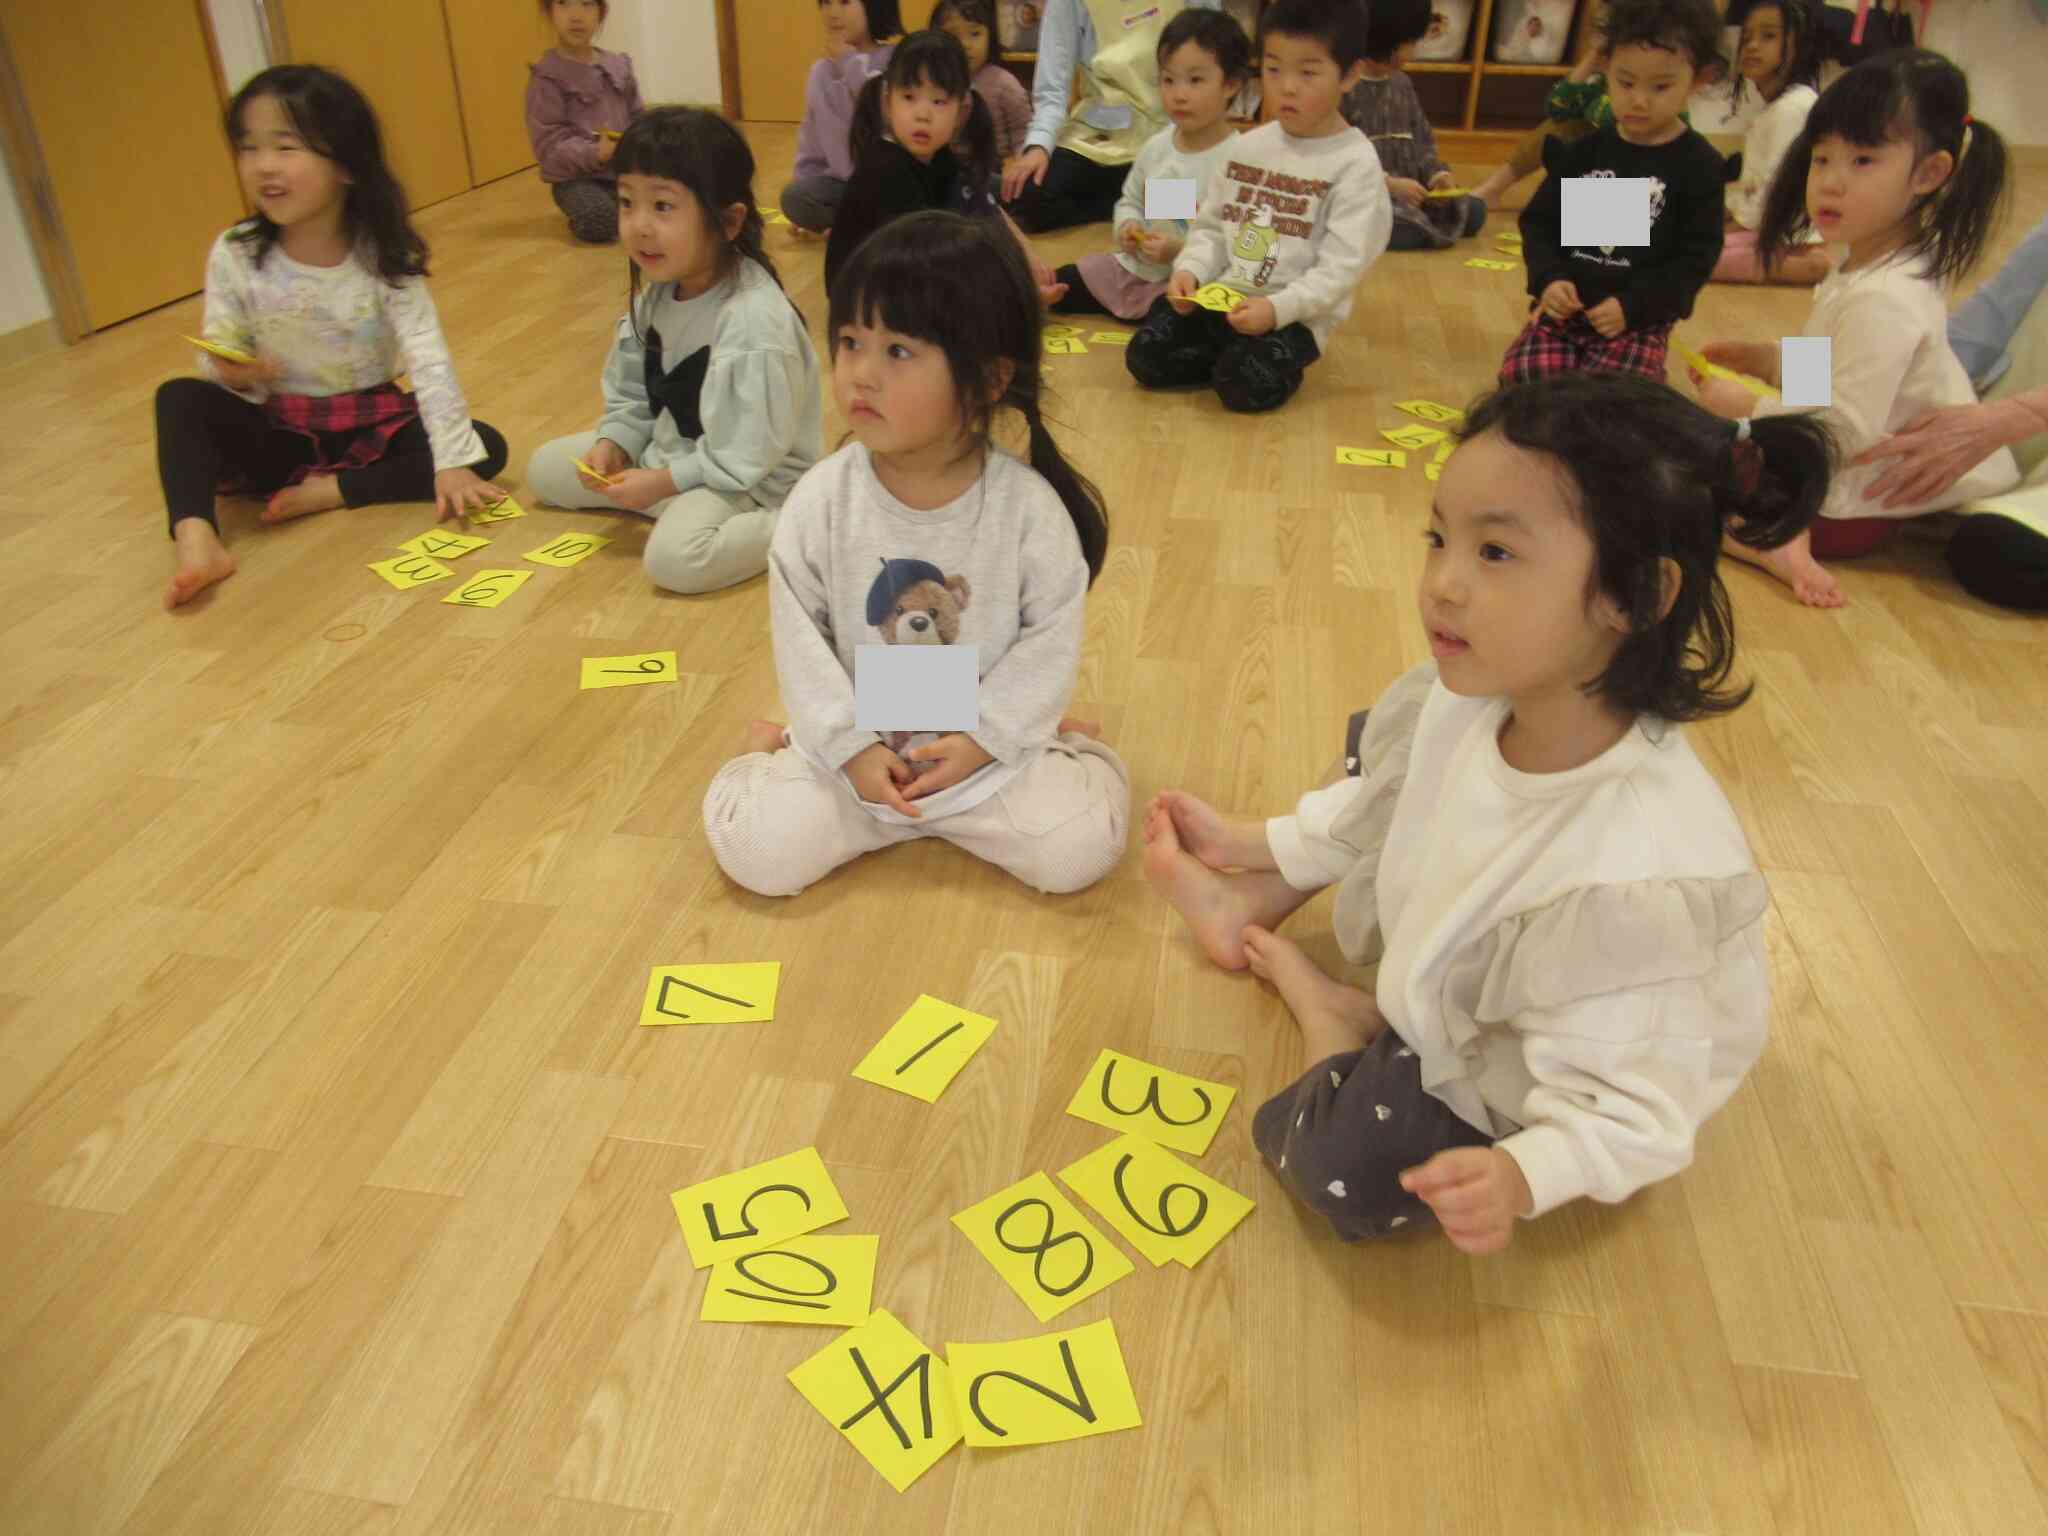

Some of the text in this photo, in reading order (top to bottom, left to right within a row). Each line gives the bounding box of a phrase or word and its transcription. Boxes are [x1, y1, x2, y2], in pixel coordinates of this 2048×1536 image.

[392, 556, 441, 581] 3
[421, 536, 469, 554] 4
[540, 539, 592, 559] 10
[655, 974, 756, 1020] 7
[895, 1021, 964, 1077] 1
[1101, 1058, 1212, 1126] 3
[702, 1184, 811, 1242] 5
[994, 1197, 1095, 1298] 8
[725, 1250, 838, 1310] 10
[840, 1346, 933, 1450] 4
[968, 1339, 1098, 1438] 2
